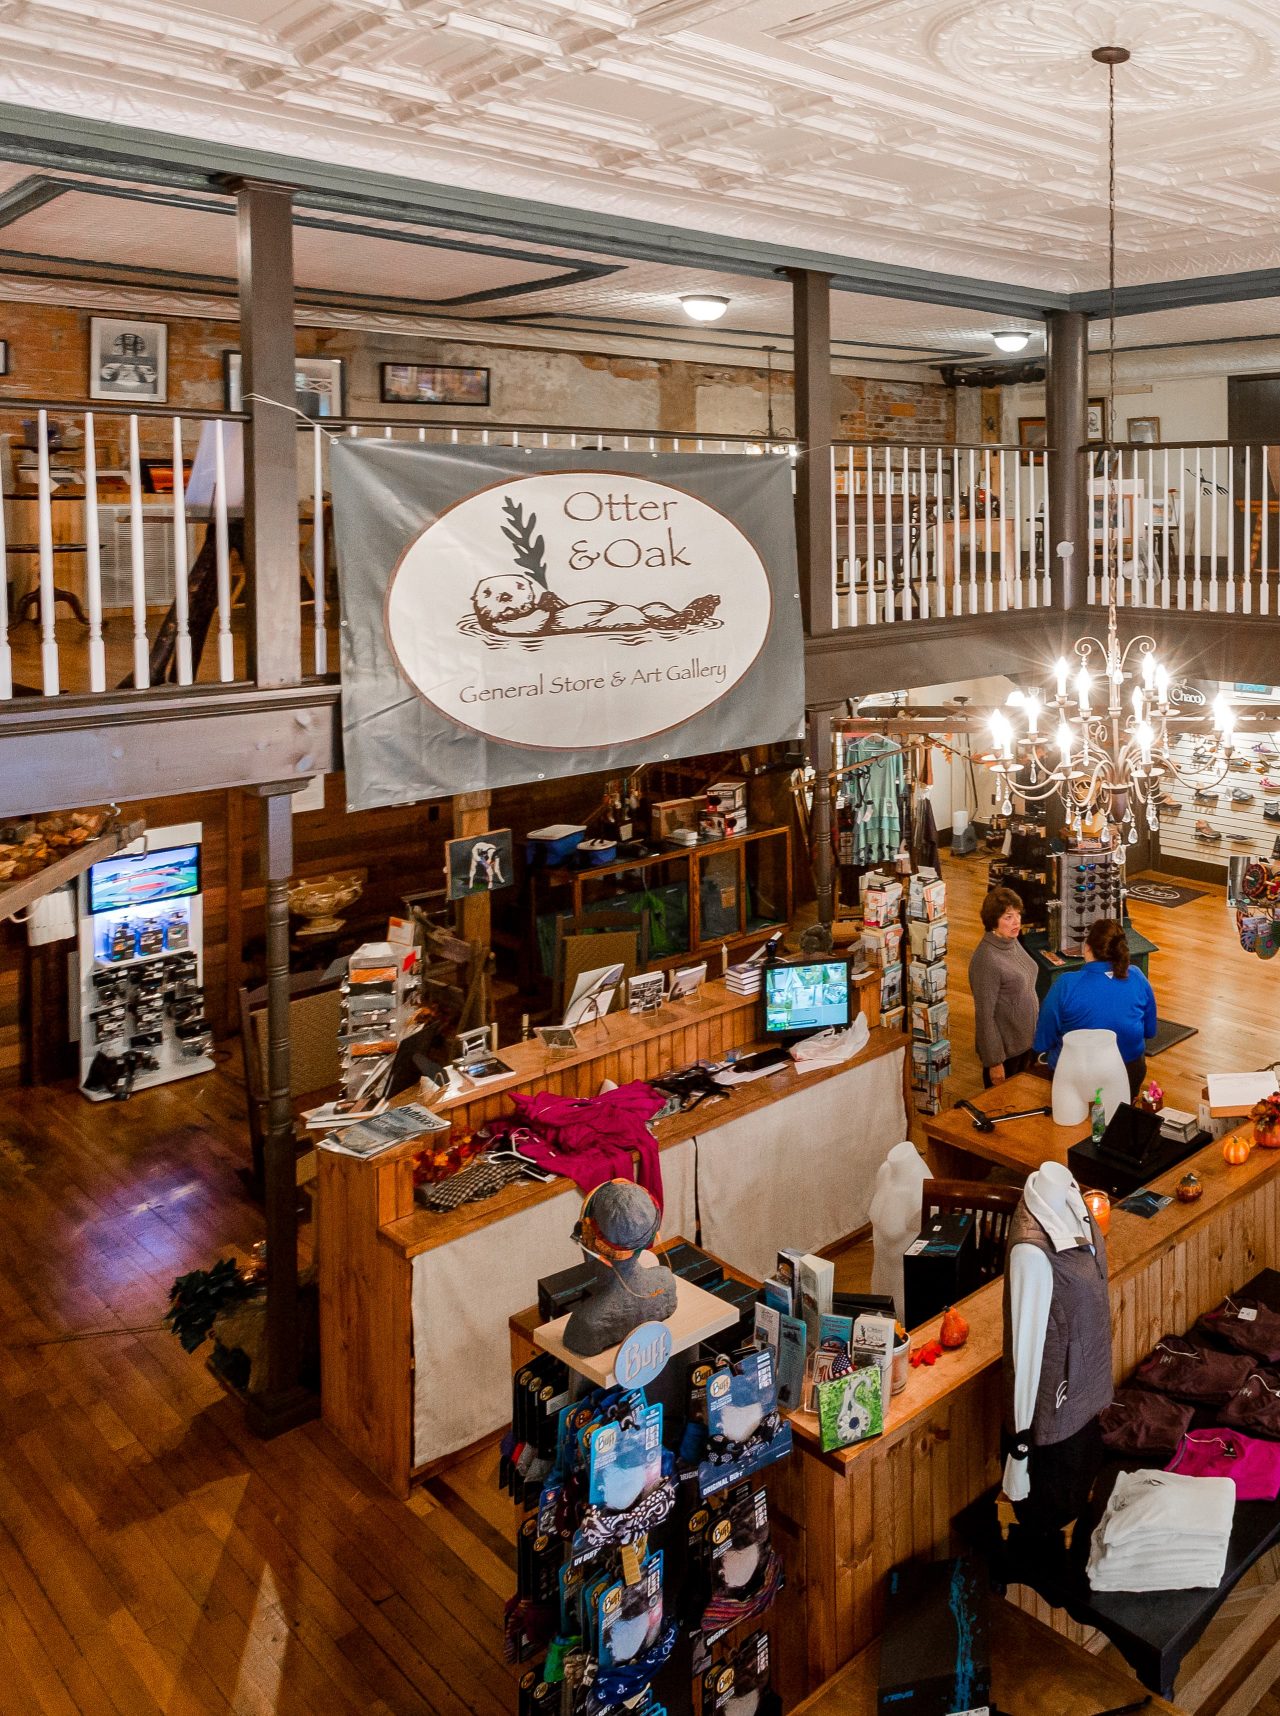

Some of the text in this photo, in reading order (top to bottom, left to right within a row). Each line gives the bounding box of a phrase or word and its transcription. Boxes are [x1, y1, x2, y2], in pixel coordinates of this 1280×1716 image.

[563, 491, 678, 522] Otter
[459, 658, 727, 704] General Store & Art Gallery
[702, 1477, 729, 1496] ORIGINAL
